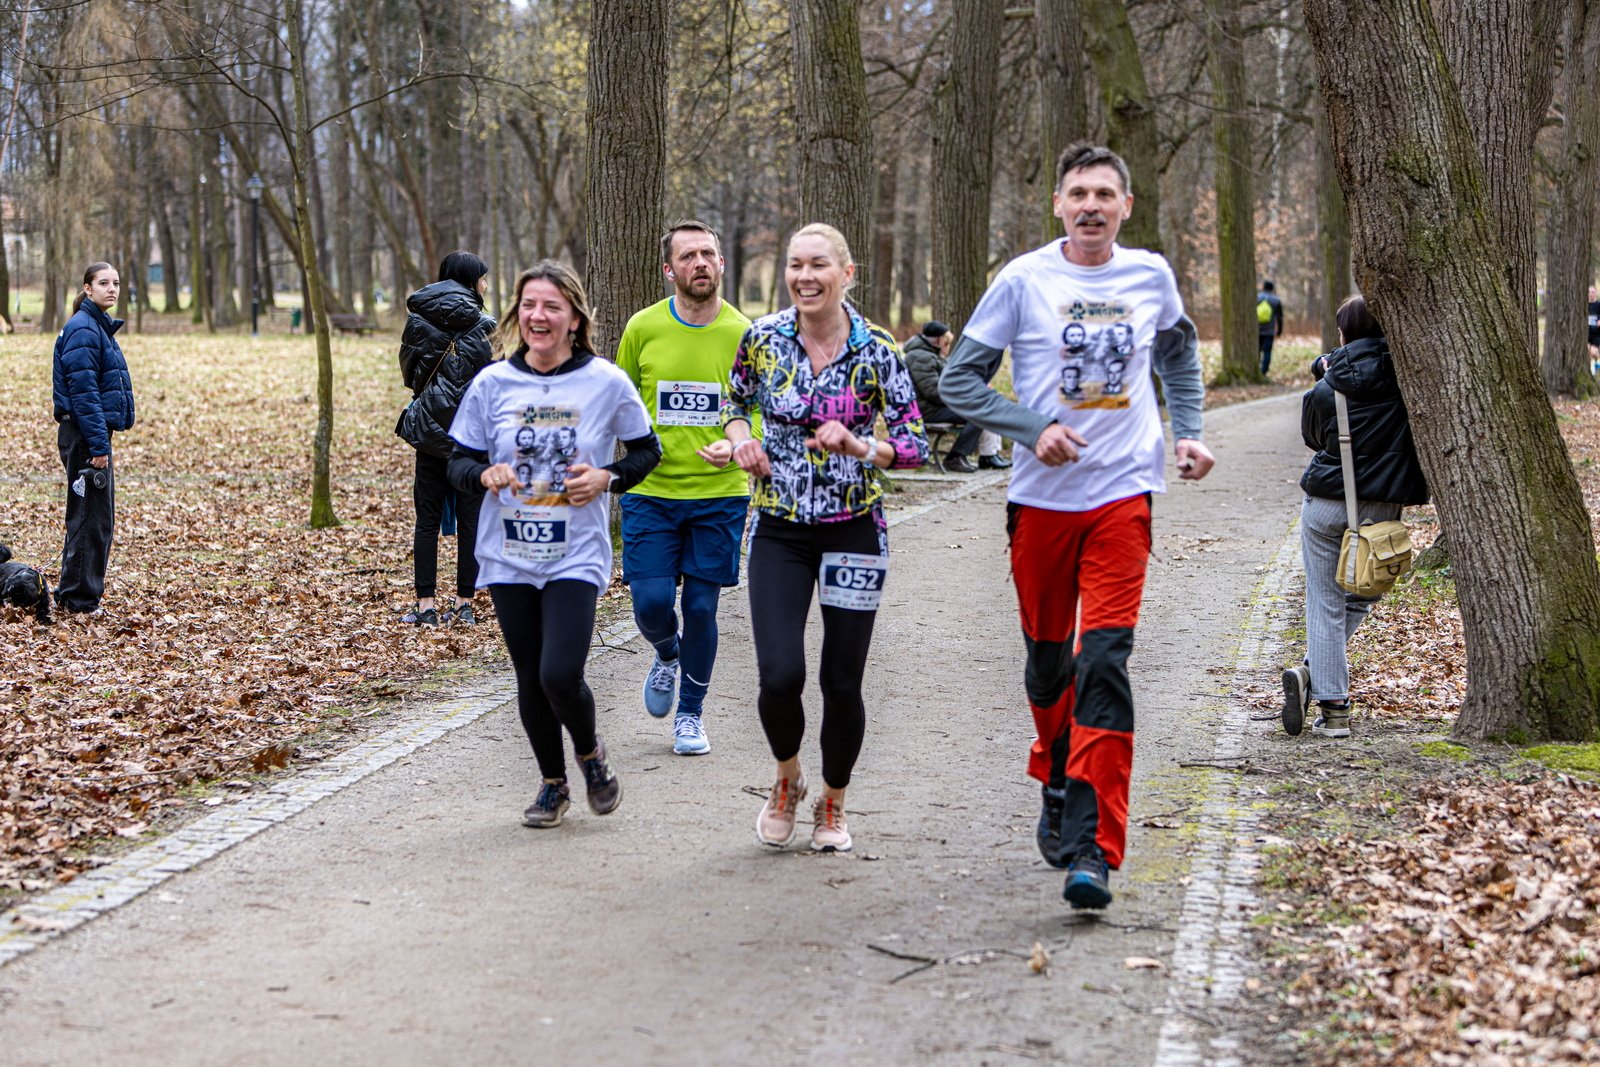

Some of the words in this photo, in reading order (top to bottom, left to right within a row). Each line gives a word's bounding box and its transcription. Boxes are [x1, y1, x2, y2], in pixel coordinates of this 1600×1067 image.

[669, 393, 710, 411] 039
[512, 521, 554, 542] 103
[835, 567, 880, 590] 052
